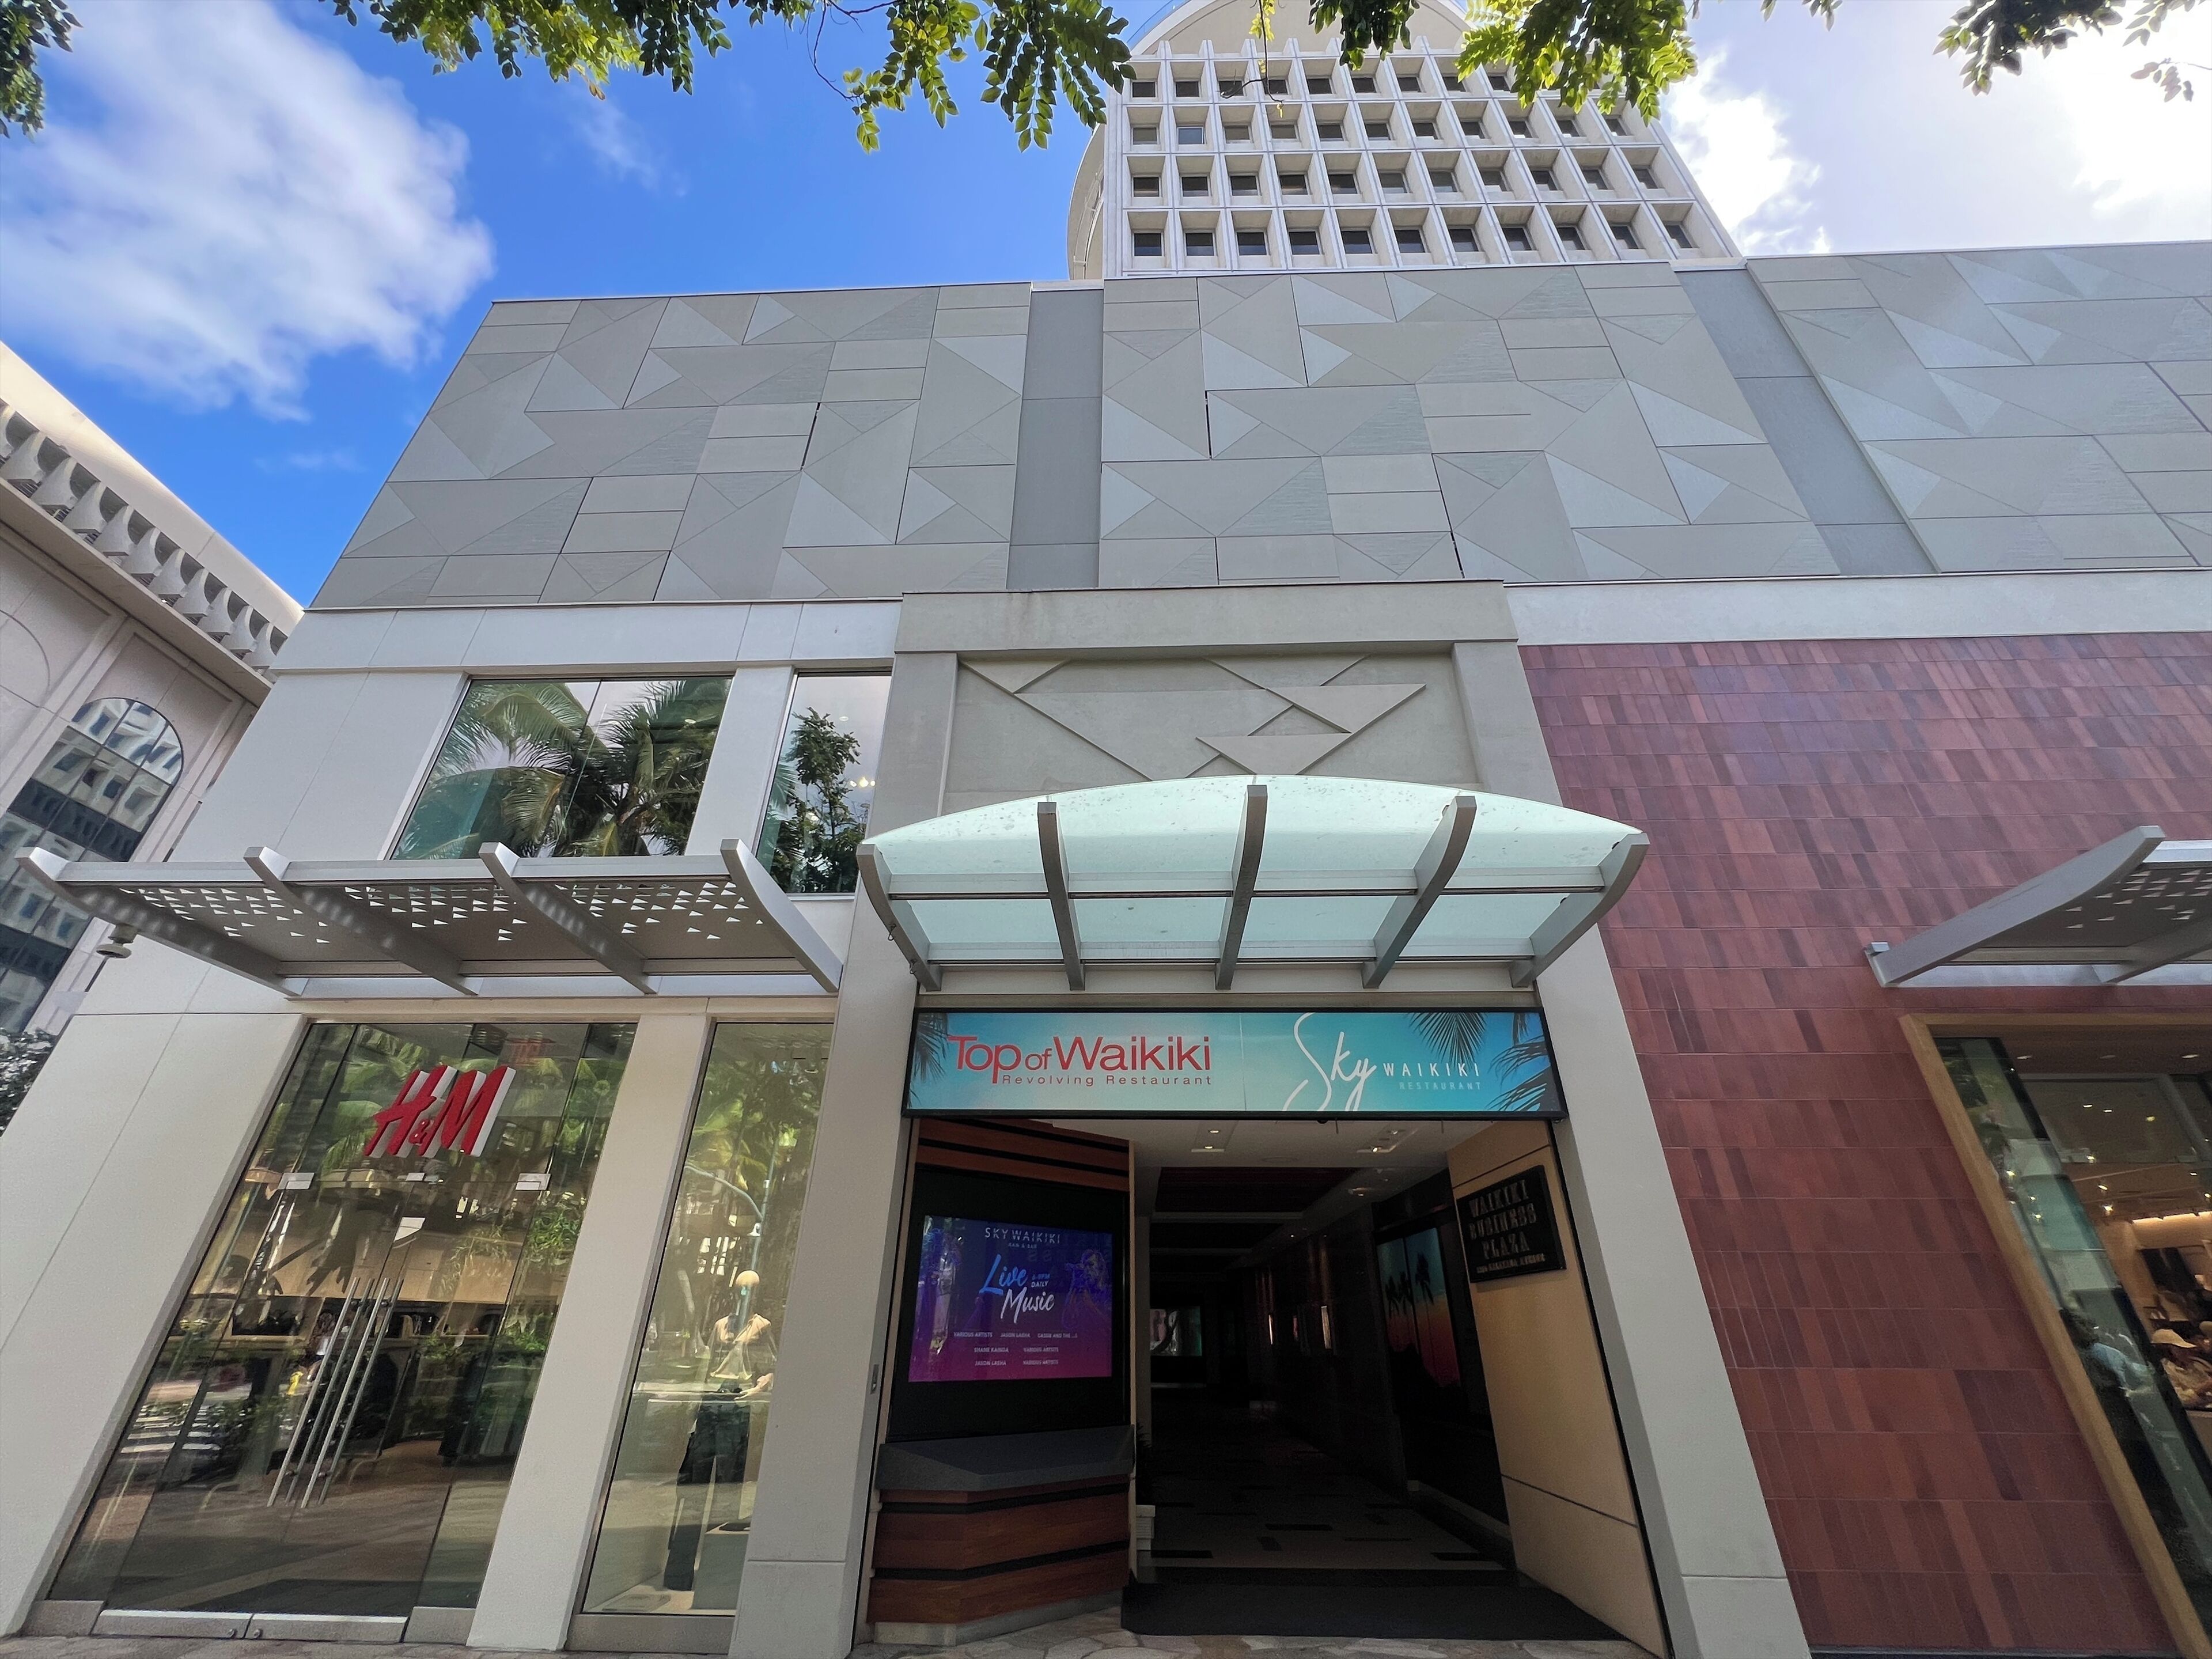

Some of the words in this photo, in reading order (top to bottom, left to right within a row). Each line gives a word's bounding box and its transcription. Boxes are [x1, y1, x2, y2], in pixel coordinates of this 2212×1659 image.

[949, 1036, 1022, 1084] Top
[1025, 1048, 1052, 1070] of
[1053, 1036, 1211, 1071] Waikiki
[1282, 1013, 1377, 1111] Sky
[1382, 1062, 1480, 1077] WAIKIKI
[1002, 1074, 1094, 1086] Revolving
[1107, 1074, 1211, 1085] Restaurant
[1399, 1081, 1482, 1090] RESTAURANT
[363, 1065, 516, 1158] H&M
[1468, 1179, 1530, 1218] WAIKIKI
[984, 1227, 1009, 1240] SKY
[1012, 1229, 1060, 1244] WAIKIKI
[1482, 1231, 1530, 1260] PLAZA
[979, 1253, 1028, 1296] Live
[1000, 1286, 1055, 1323] Music
